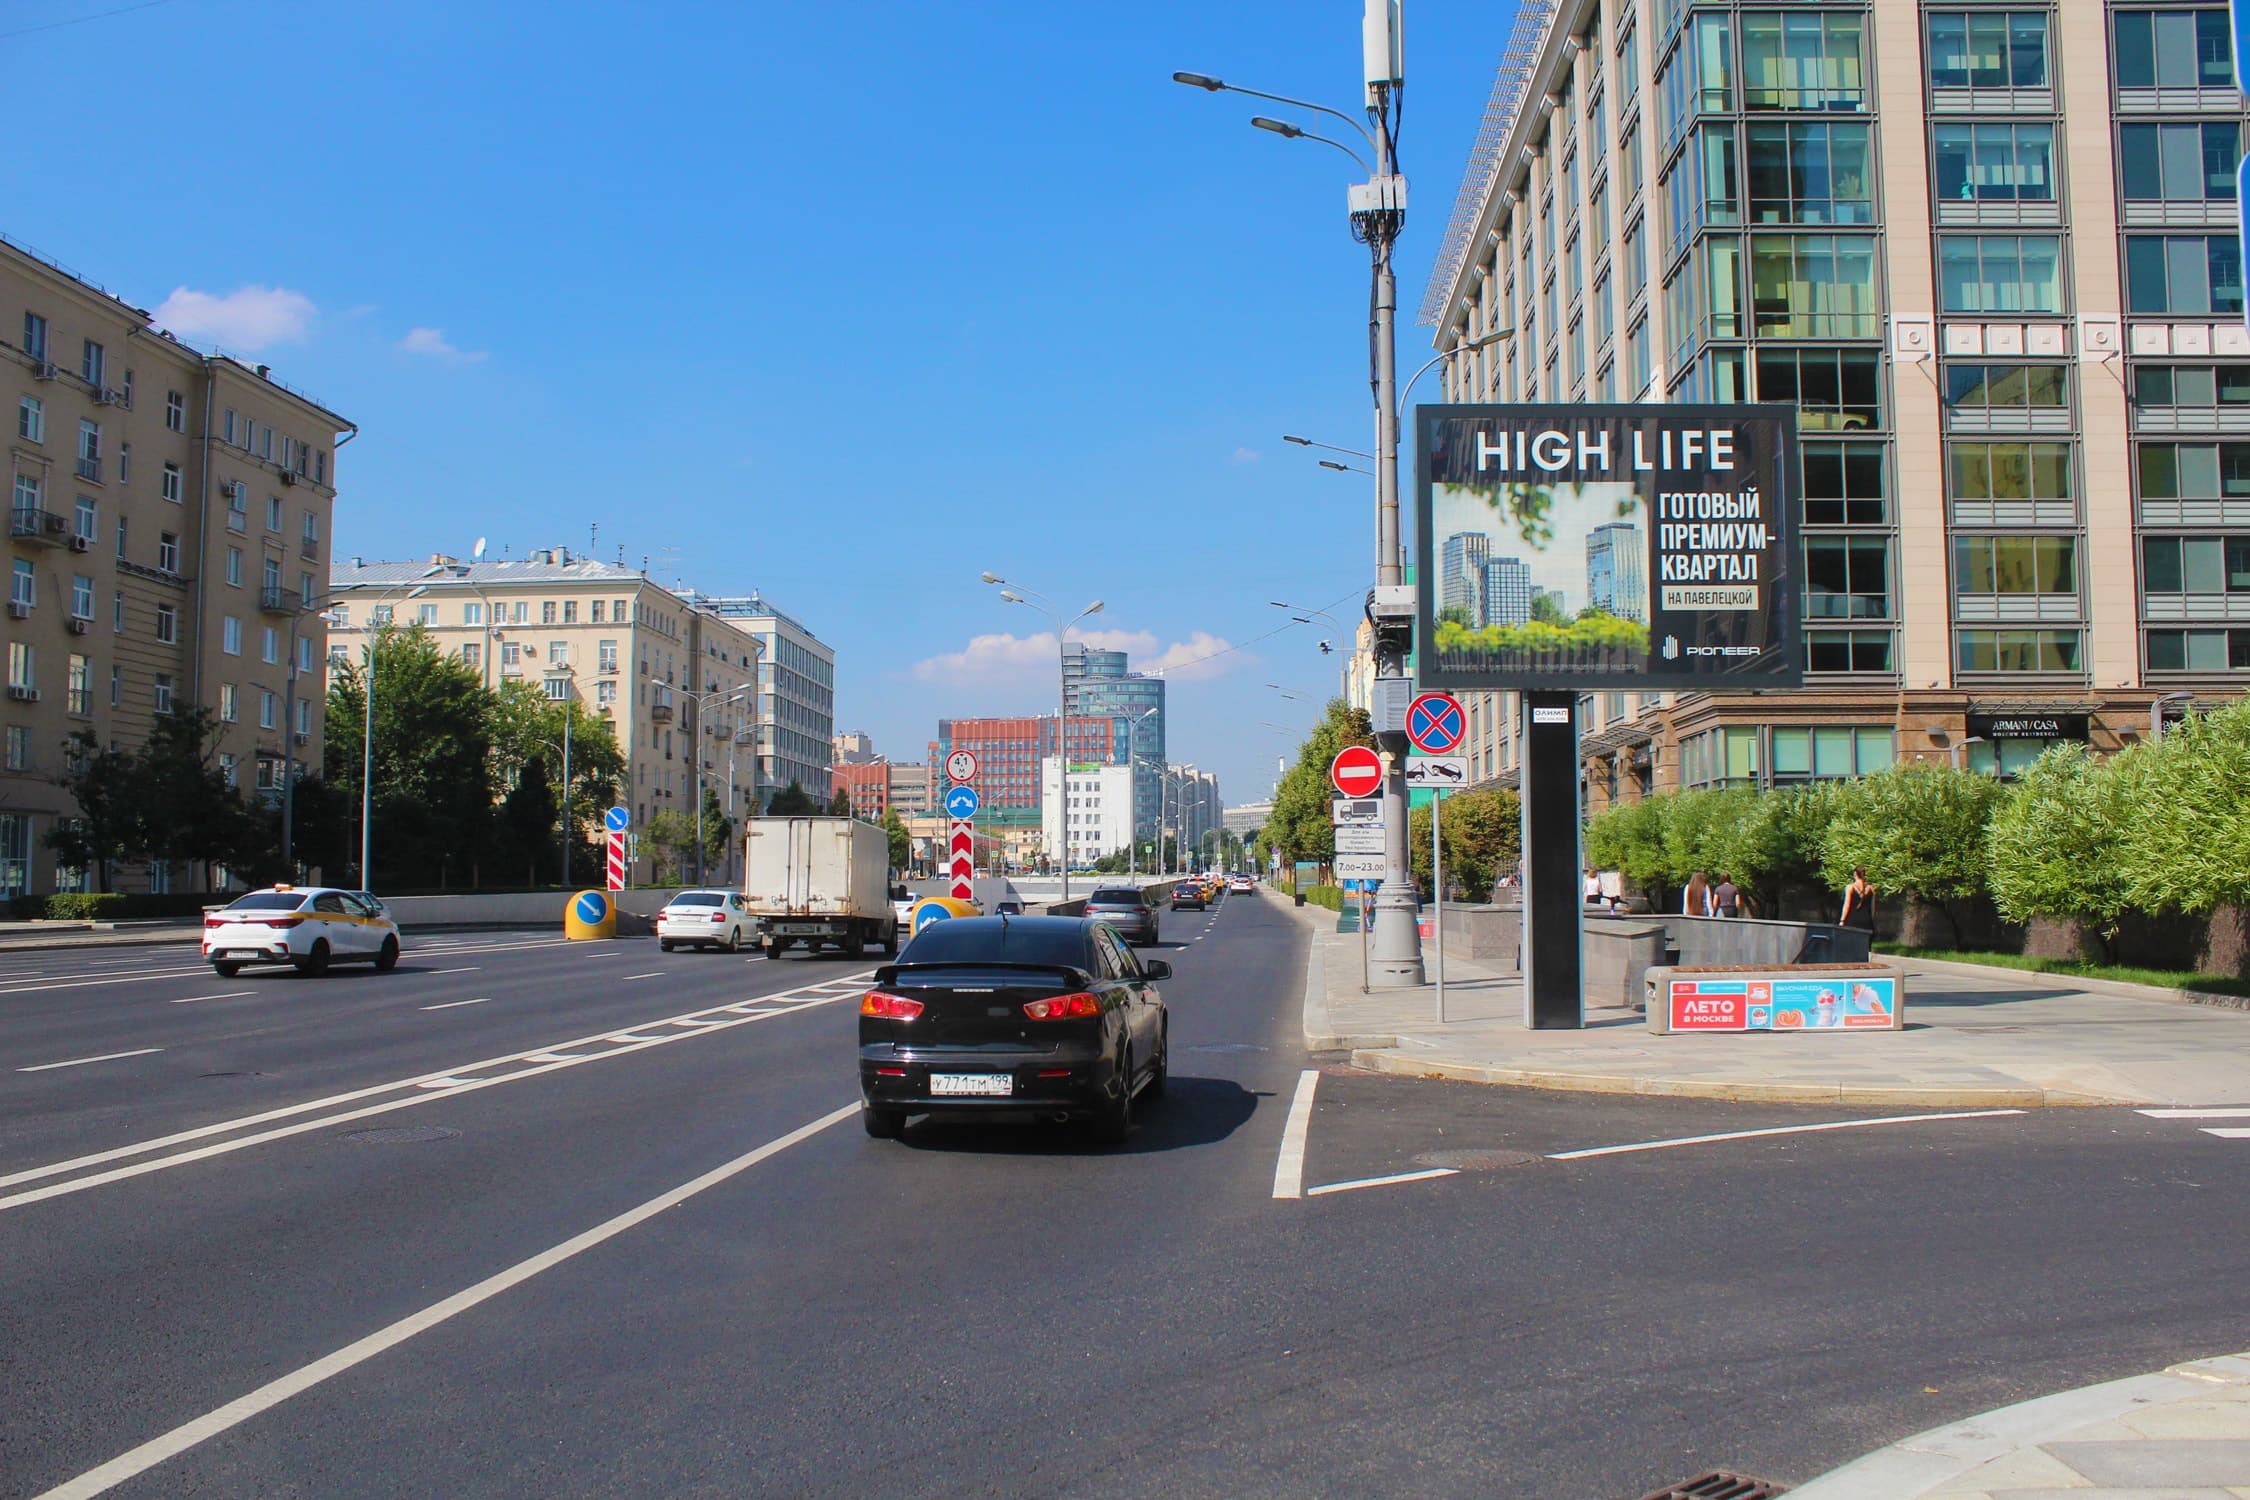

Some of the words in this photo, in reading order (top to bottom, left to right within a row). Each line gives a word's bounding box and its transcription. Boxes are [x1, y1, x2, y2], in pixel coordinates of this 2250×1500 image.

[1477, 430, 1610, 472] HIGH
[1633, 430, 1735, 470] LIFE
[1659, 487, 1760, 519] ГОТОВЫЙ
[1660, 523, 1776, 550] ПРЕМИУМ-
[1661, 554, 1758, 580] КВАРТАЛ
[1668, 592, 1681, 604] НА
[1685, 590, 1753, 605] ПАВЕЛЕЦКОЙ
[1686, 646, 1761, 656] PIONEER
[1684, 1000, 1735, 1013] ЛЕТО
[1693, 1015, 1735, 1023] МОСКВЕ
